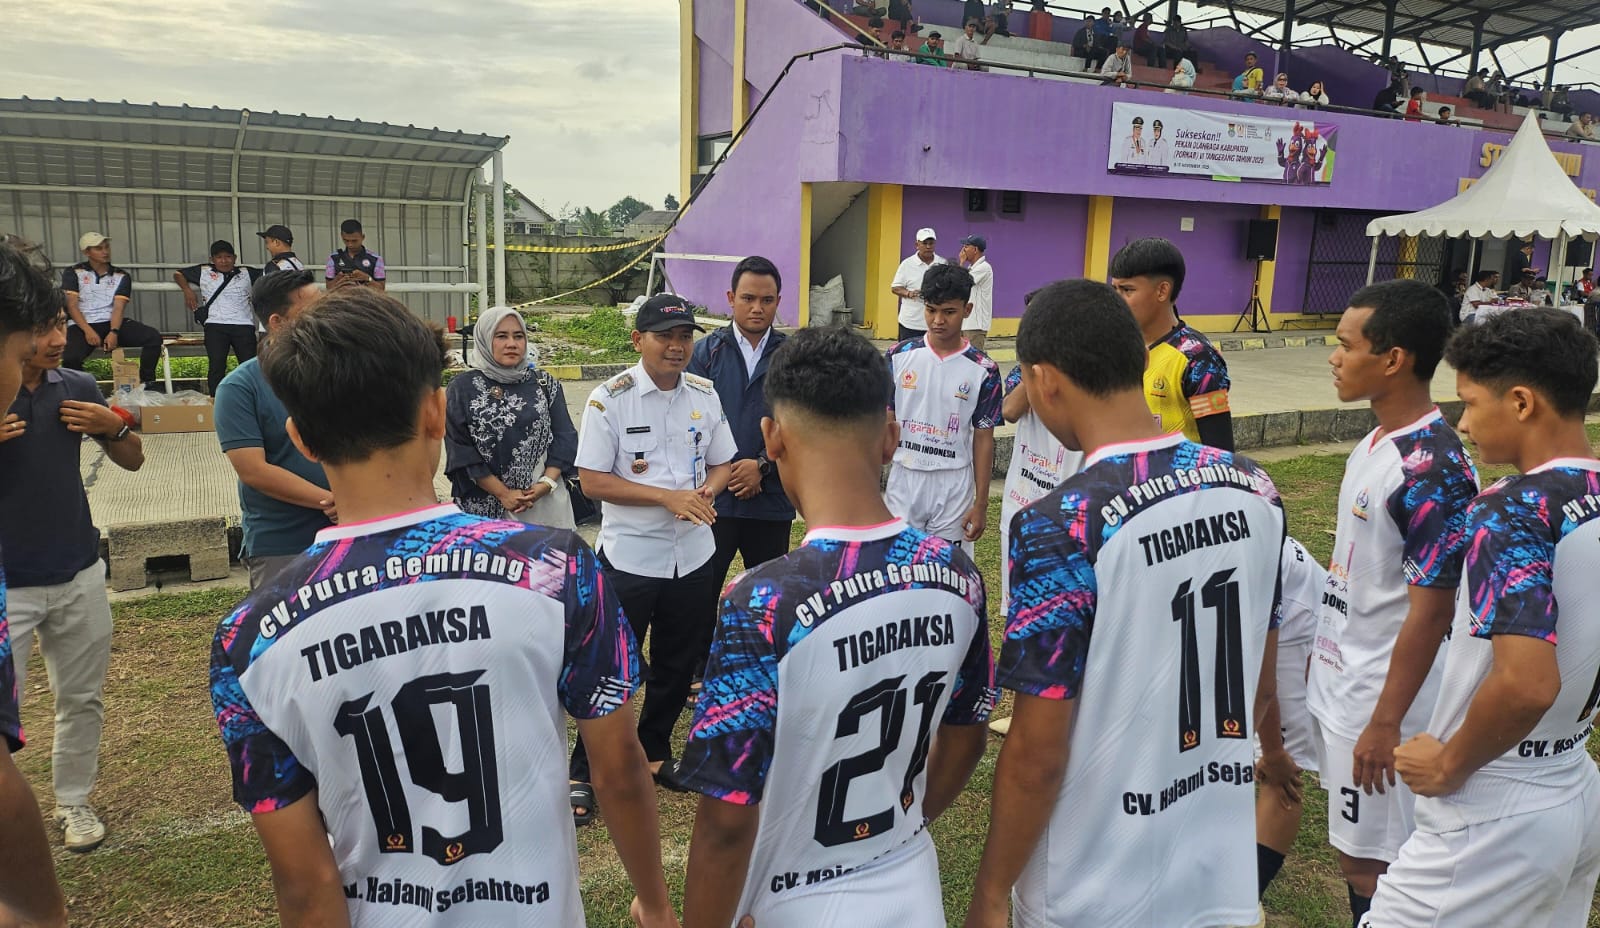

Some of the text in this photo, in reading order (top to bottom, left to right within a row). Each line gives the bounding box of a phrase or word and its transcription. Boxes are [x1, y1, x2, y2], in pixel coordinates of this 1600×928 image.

[1175, 140, 1192, 149] PEKAN
[1220, 143, 1249, 153] KABUPATEN
[1176, 128, 1222, 142] Sukseskan!!
[1205, 153, 1235, 162] TANGERANG
[1212, 393, 1227, 410] C
[921, 445, 956, 459] INDONESIA
[1100, 463, 1258, 527] CV. Putra Gemilang
[1562, 498, 1590, 523] CV.
[1138, 509, 1251, 567] TIGARAKSA
[259, 548, 526, 640] CV. Putra Gemilang
[795, 561, 968, 628] CV. Putra Gemilang
[301, 604, 491, 683] TIGARAKSA
[833, 613, 954, 673] TIGARAKSA
[1170, 566, 1248, 754] 11
[333, 668, 505, 867] 19
[813, 670, 949, 848] 21
[1518, 740, 1549, 758] CV.
[1122, 761, 1254, 816] CV. Hajami Seja
[1340, 786, 1360, 824] 3
[436, 877, 550, 913] Sejahtera
[770, 871, 801, 894] CV.
